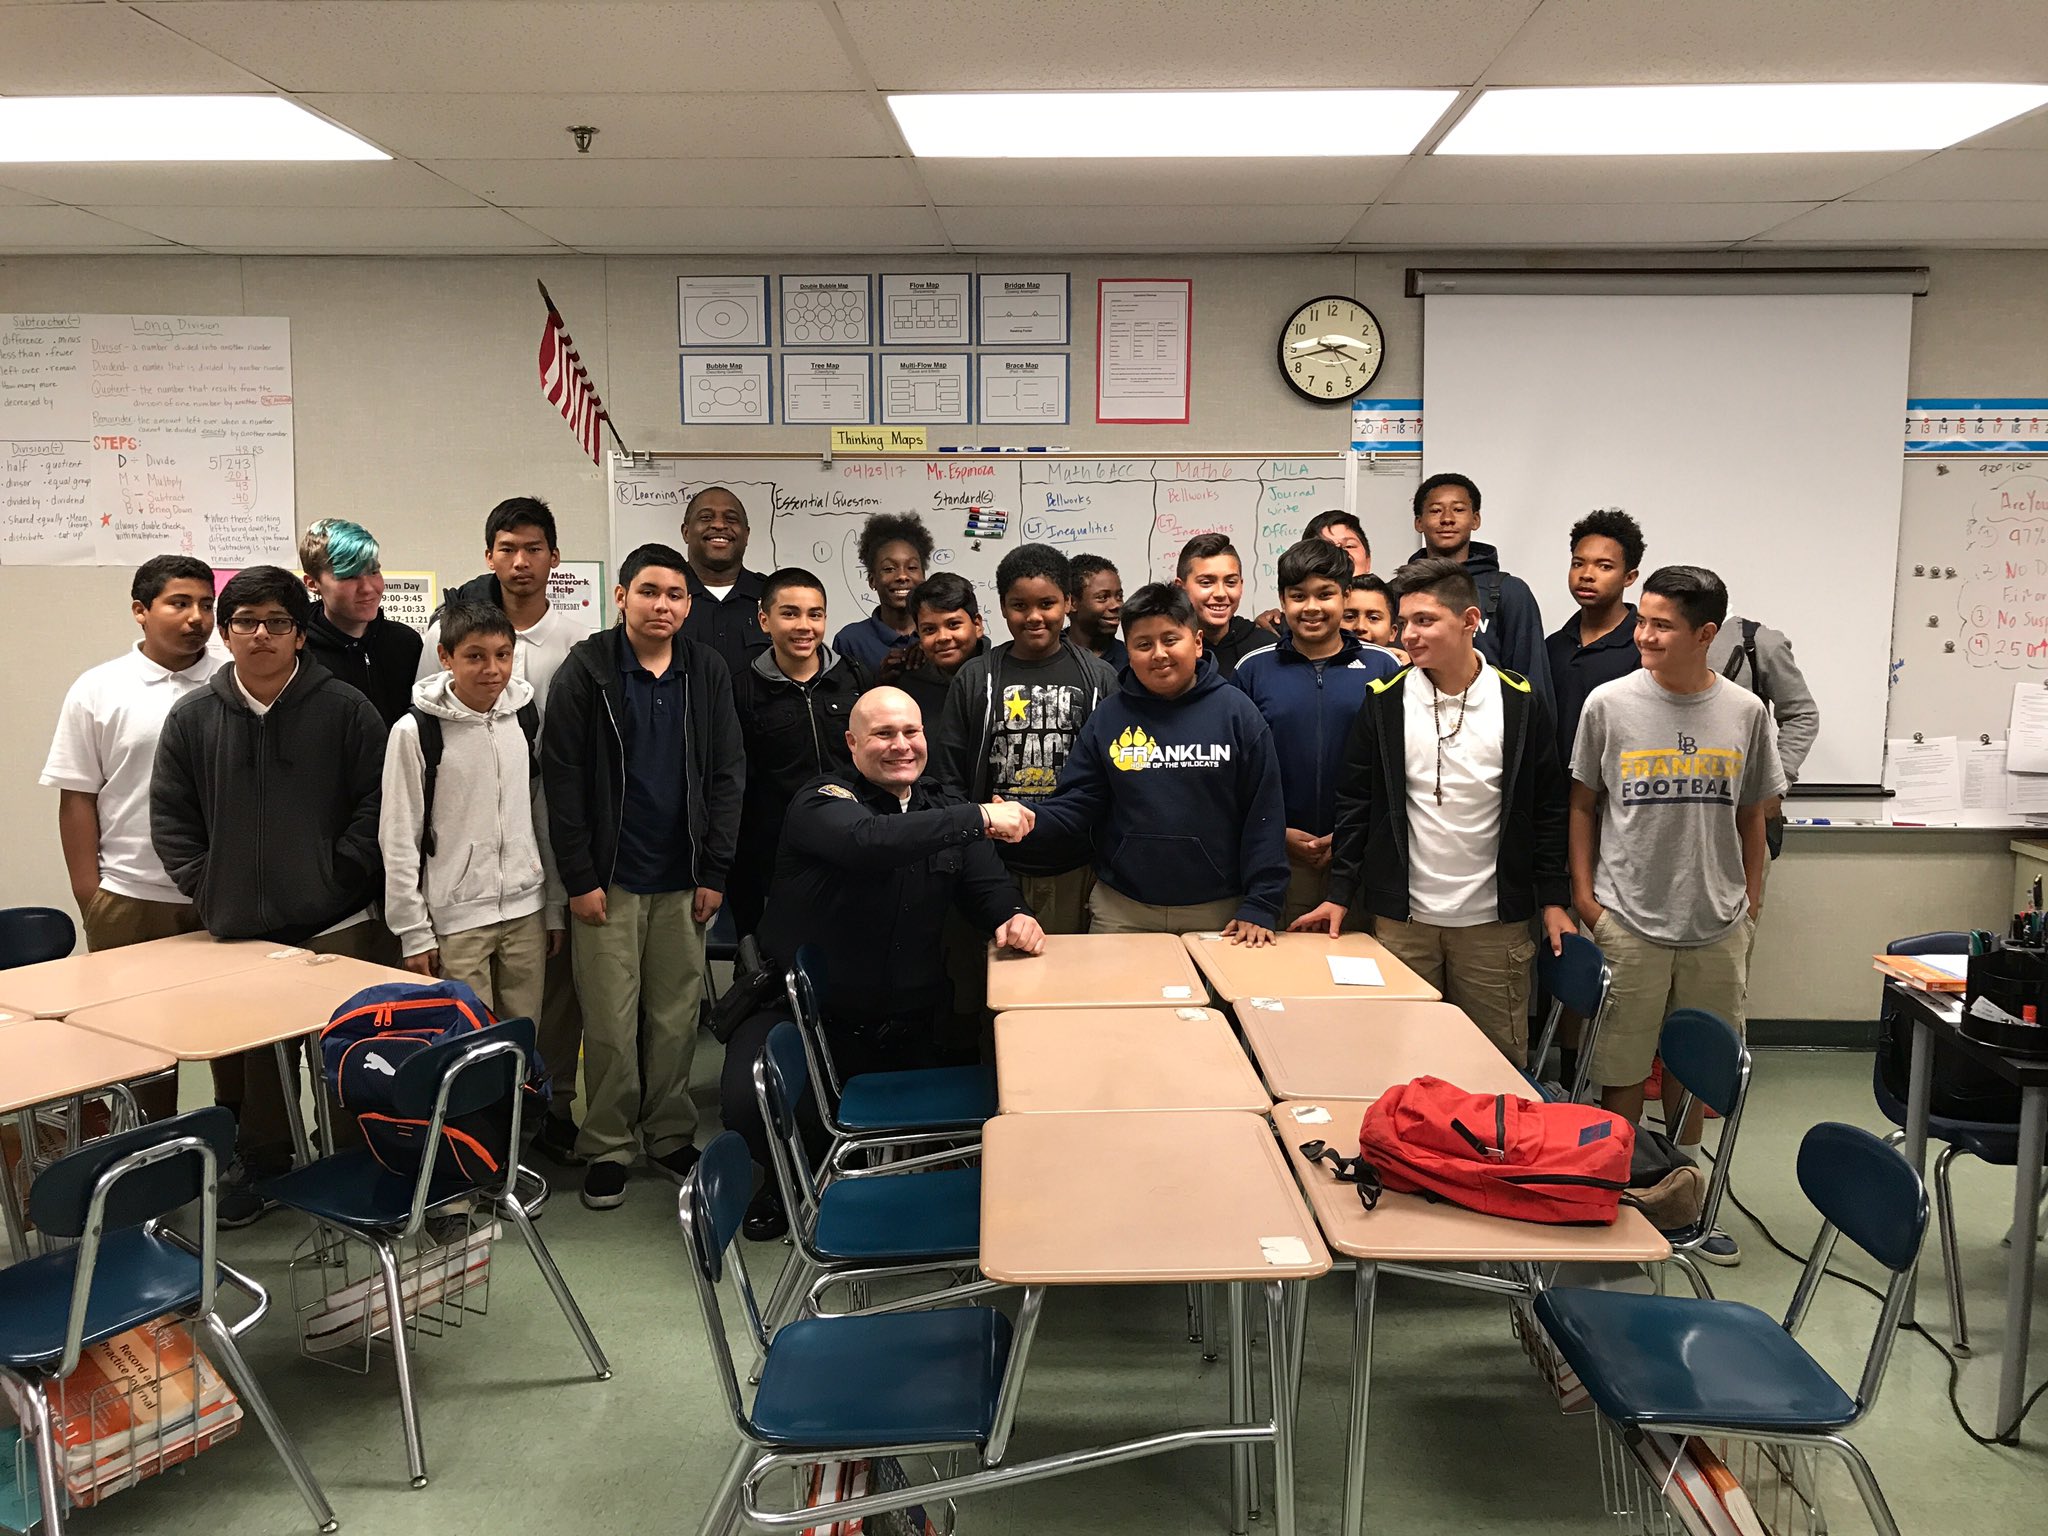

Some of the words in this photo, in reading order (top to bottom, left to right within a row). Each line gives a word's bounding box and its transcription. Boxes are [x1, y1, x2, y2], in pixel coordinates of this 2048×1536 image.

[1310, 309, 1319, 322] 11
[1327, 304, 1338, 317] 12
[1350, 310, 1354, 322] 1
[131, 316, 173, 341] Long
[177, 318, 220, 330] Division
[1295, 323, 1306, 335] 10
[1362, 324, 1369, 336] 2
[2, 332, 44, 346] difference
[19, 348, 41, 359] than
[49, 345, 75, 358] fewer
[22, 367, 40, 375] over
[50, 364, 77, 372] remain
[826, 362, 840, 370] Map
[1294, 362, 1302, 373] 8
[1359, 362, 1367, 374] 4
[1308, 375, 1315, 387] 7
[1326, 381, 1333, 392] 6
[1345, 376, 1352, 388] 5
[157, 384, 184, 393] number
[3, 397, 41, 407] decreased
[43, 397, 54, 410] by
[164, 398, 173, 407] of
[1356, 424, 1374, 435] -20
[1375, 424, 1389, 435] -19
[1392, 424, 1406, 435] -18
[1409, 424, 1423, 435] -17
[1904, 424, 1911, 434] 2
[1920, 424, 1930, 434] 13
[1938, 424, 1948, 434] 14
[1956, 424, 1966, 434] 15
[1974, 424, 1984, 434] 16
[1993, 424, 2003, 434] 17
[2011, 424, 2021, 434] 18
[2029, 424, 2039, 434] 19
[93, 435, 142, 450] STEPS:
[838, 432, 884, 450] Thinking
[891, 431, 924, 447] Maps
[7, 459, 28, 473] half
[46, 459, 82, 475] quotient
[118, 454, 127, 468] D
[146, 453, 176, 467] Divide
[208, 456, 218, 470] 5
[226, 458, 251, 470] 243
[844, 462, 907, 481] 04/25/17
[927, 462, 947, 480] Mr.
[949, 462, 995, 484] Espinoza
[1048, 463, 1092, 481] Math
[1096, 464, 1105, 476] 6
[1109, 463, 1136, 478] ACC
[1176, 461, 1219, 479] Math
[1221, 463, 1233, 477] 6
[1272, 462, 1309, 479] MLA
[6, 477, 31, 489] divisor
[48, 476, 70, 490] equal
[119, 472, 129, 485] M
[147, 472, 182, 491] Multiply
[236, 481, 249, 491] 43
[122, 488, 132, 503] S
[147, 490, 185, 503] Subtract
[620, 486, 629, 501] K
[634, 485, 679, 504] Learning
[678, 487, 698, 502] Tar
[776, 488, 829, 511] Essential
[1046, 492, 1092, 507] Bellworks
[1168, 487, 1220, 503] Bellworks
[1268, 485, 1316, 501] Journal
[7, 495, 30, 507] divided
[32, 496, 40, 509] by
[51, 494, 85, 506] dividend
[126, 502, 133, 515] B
[149, 503, 172, 519] Bring
[173, 504, 192, 514] Down
[37, 513, 63, 527] equally
[115, 519, 138, 532] always
[141, 520, 161, 531] double
[255, 513, 281, 527] nothing
[1160, 518, 1173, 528] LT
[8, 531, 44, 541] distribute
[73, 531, 83, 541] up
[115, 531, 130, 540] with
[231, 525, 248, 536] bring
[268, 525, 281, 533] the
[1027, 524, 1042, 534] LT
[1046, 521, 1114, 541] Inequalities
[209, 534, 241, 543] difference
[209, 543, 217, 554] by
[403, 582, 420, 591] Day
[553, 586, 574, 594] Help
[381, 594, 423, 602] 9:00-9:45
[1998, 609, 2016, 629] No
[1677, 732, 1698, 755] LB
[1119, 744, 1231, 762] FRANKLIN
[1180, 760, 1220, 768] WILDCATS
[1620, 756, 1741, 780] FRANKLI
[1622, 778, 1732, 798] FOOTBAL
[99, 1341, 129, 1375] Practice
[120, 1344, 149, 1374] Record
[143, 1374, 163, 1393] ad
